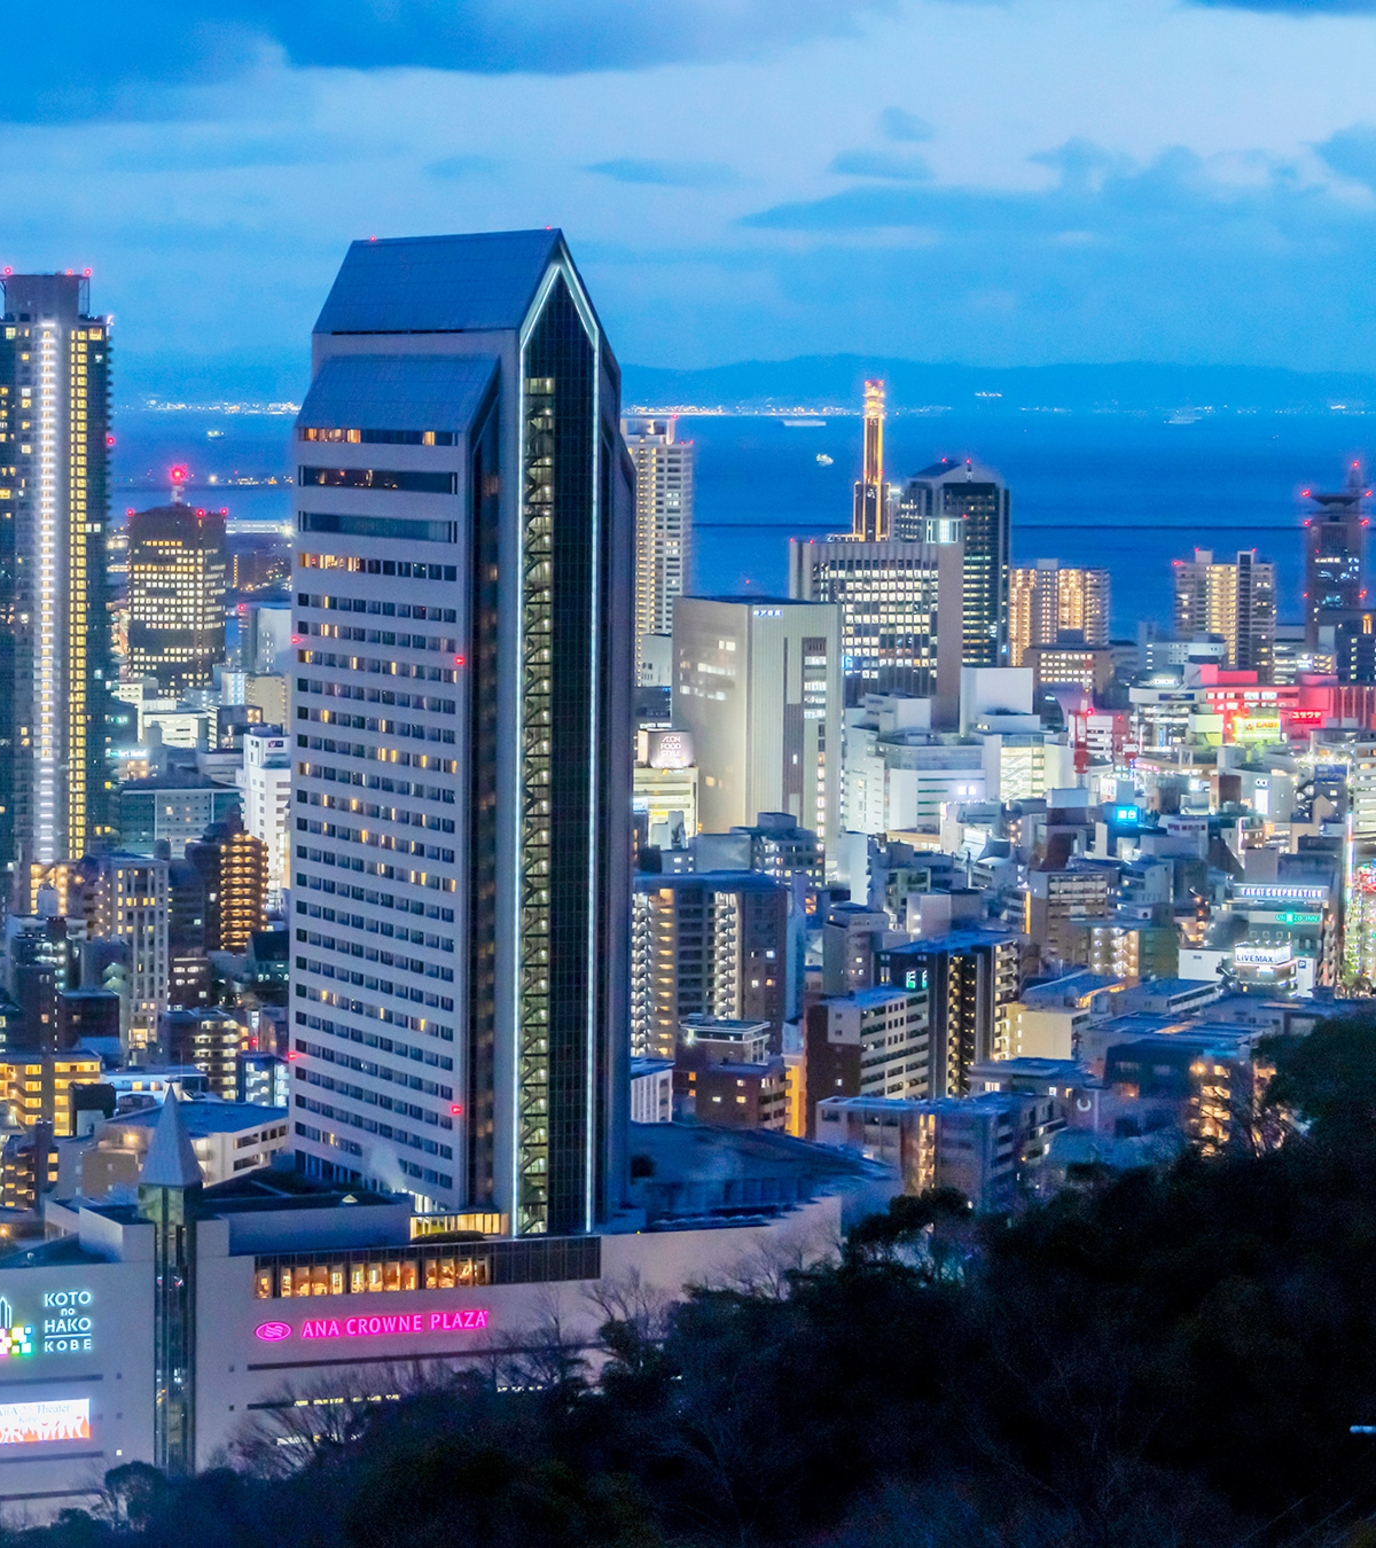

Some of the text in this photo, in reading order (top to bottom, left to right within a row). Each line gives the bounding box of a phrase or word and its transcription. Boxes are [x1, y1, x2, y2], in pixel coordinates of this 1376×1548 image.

[1241, 888, 1324, 898] TAKAI CORPORATION
[45, 1291, 92, 1307] KOTO
[61, 1308, 75, 1316] no
[45, 1317, 92, 1333] HAKO
[302, 1311, 487, 1338] ANA CROWNE PLAZA
[45, 1339, 92, 1352] KOBE
